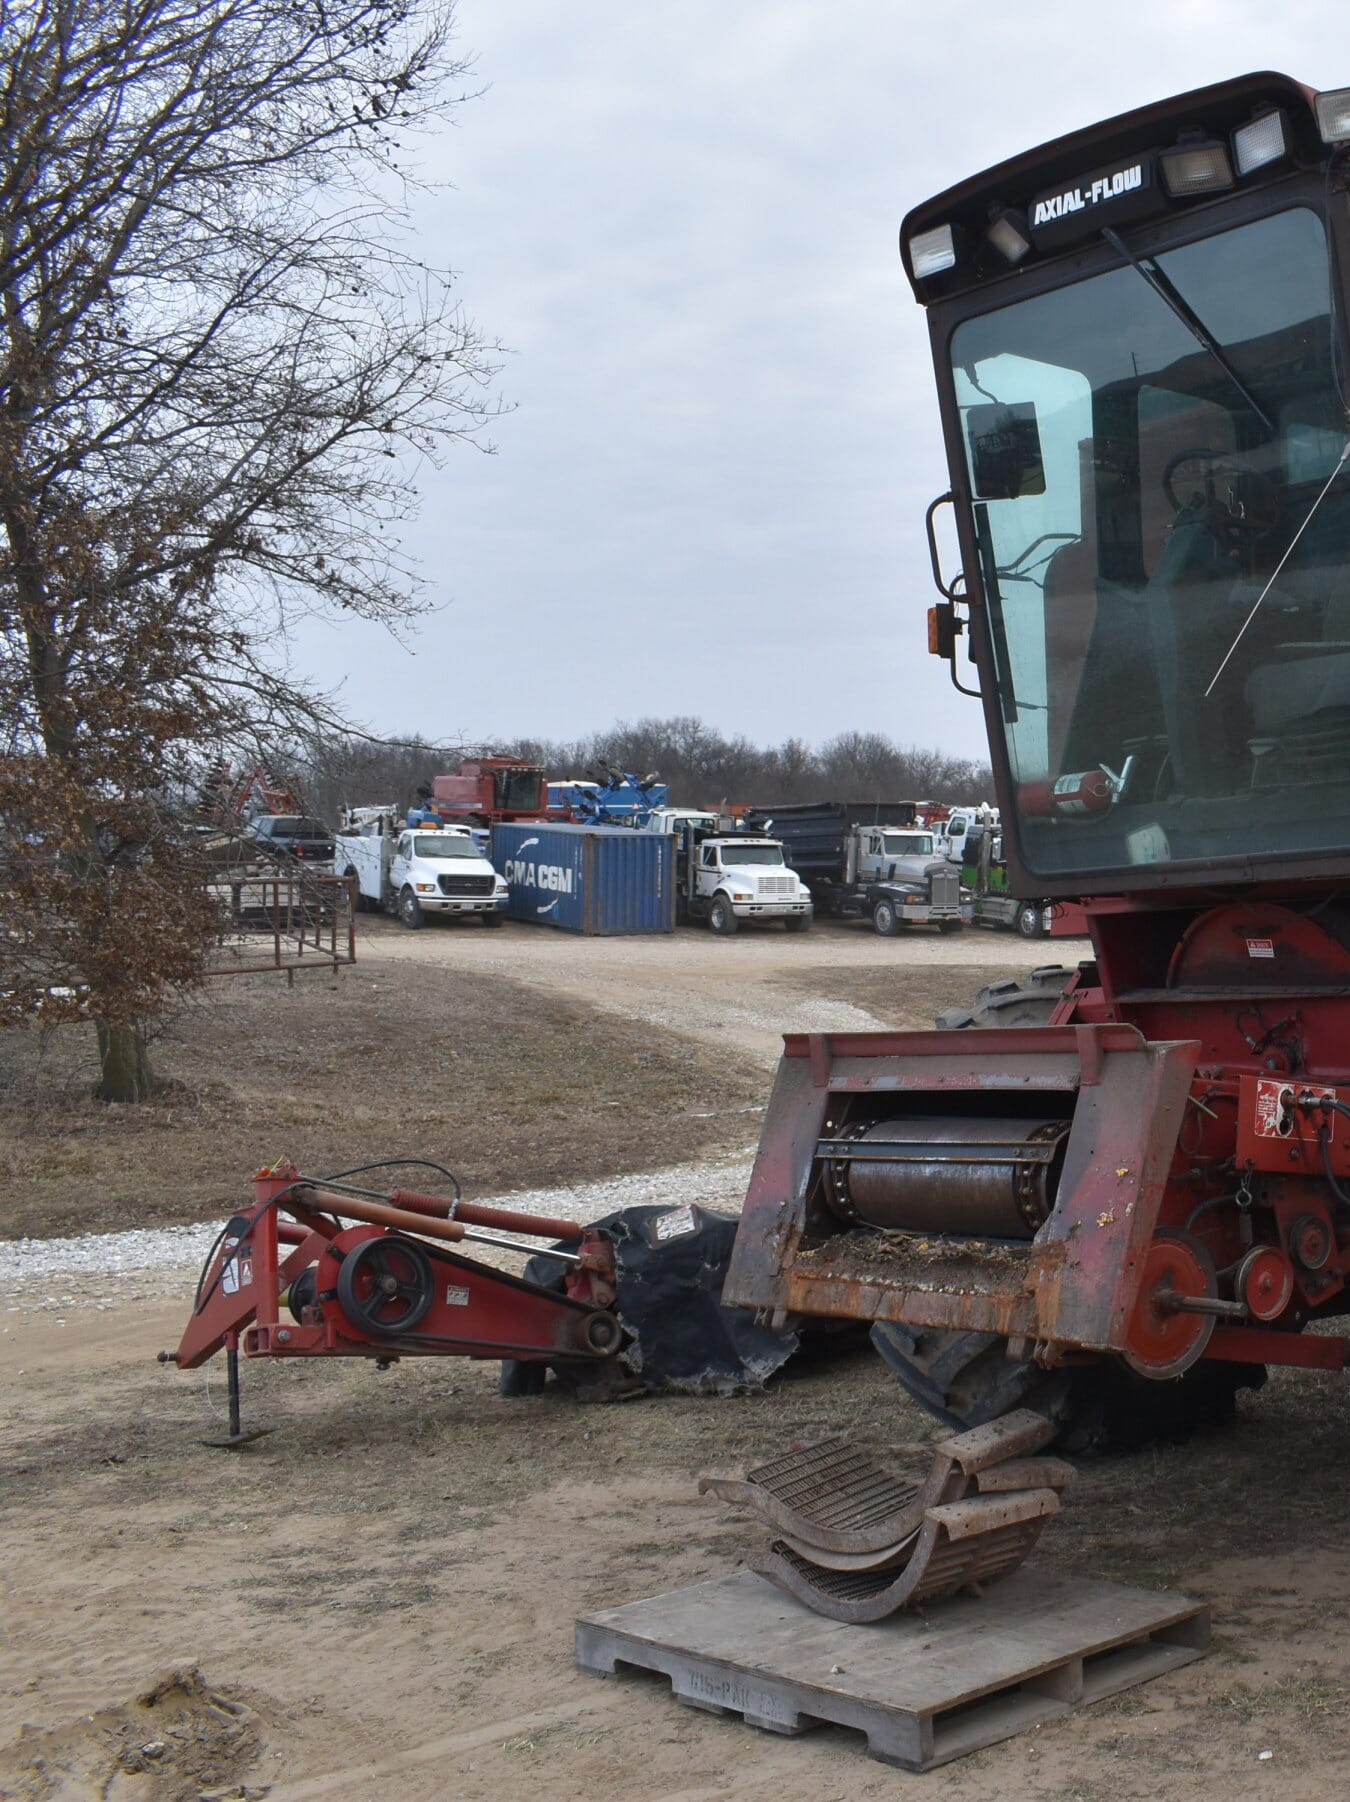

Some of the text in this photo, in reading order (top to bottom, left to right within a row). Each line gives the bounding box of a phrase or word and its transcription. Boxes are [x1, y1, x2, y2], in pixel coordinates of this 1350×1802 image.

[1034, 164, 1142, 226] AXIAL-FLOW
[504, 859, 536, 888] CMA
[537, 864, 572, 894] CGM
